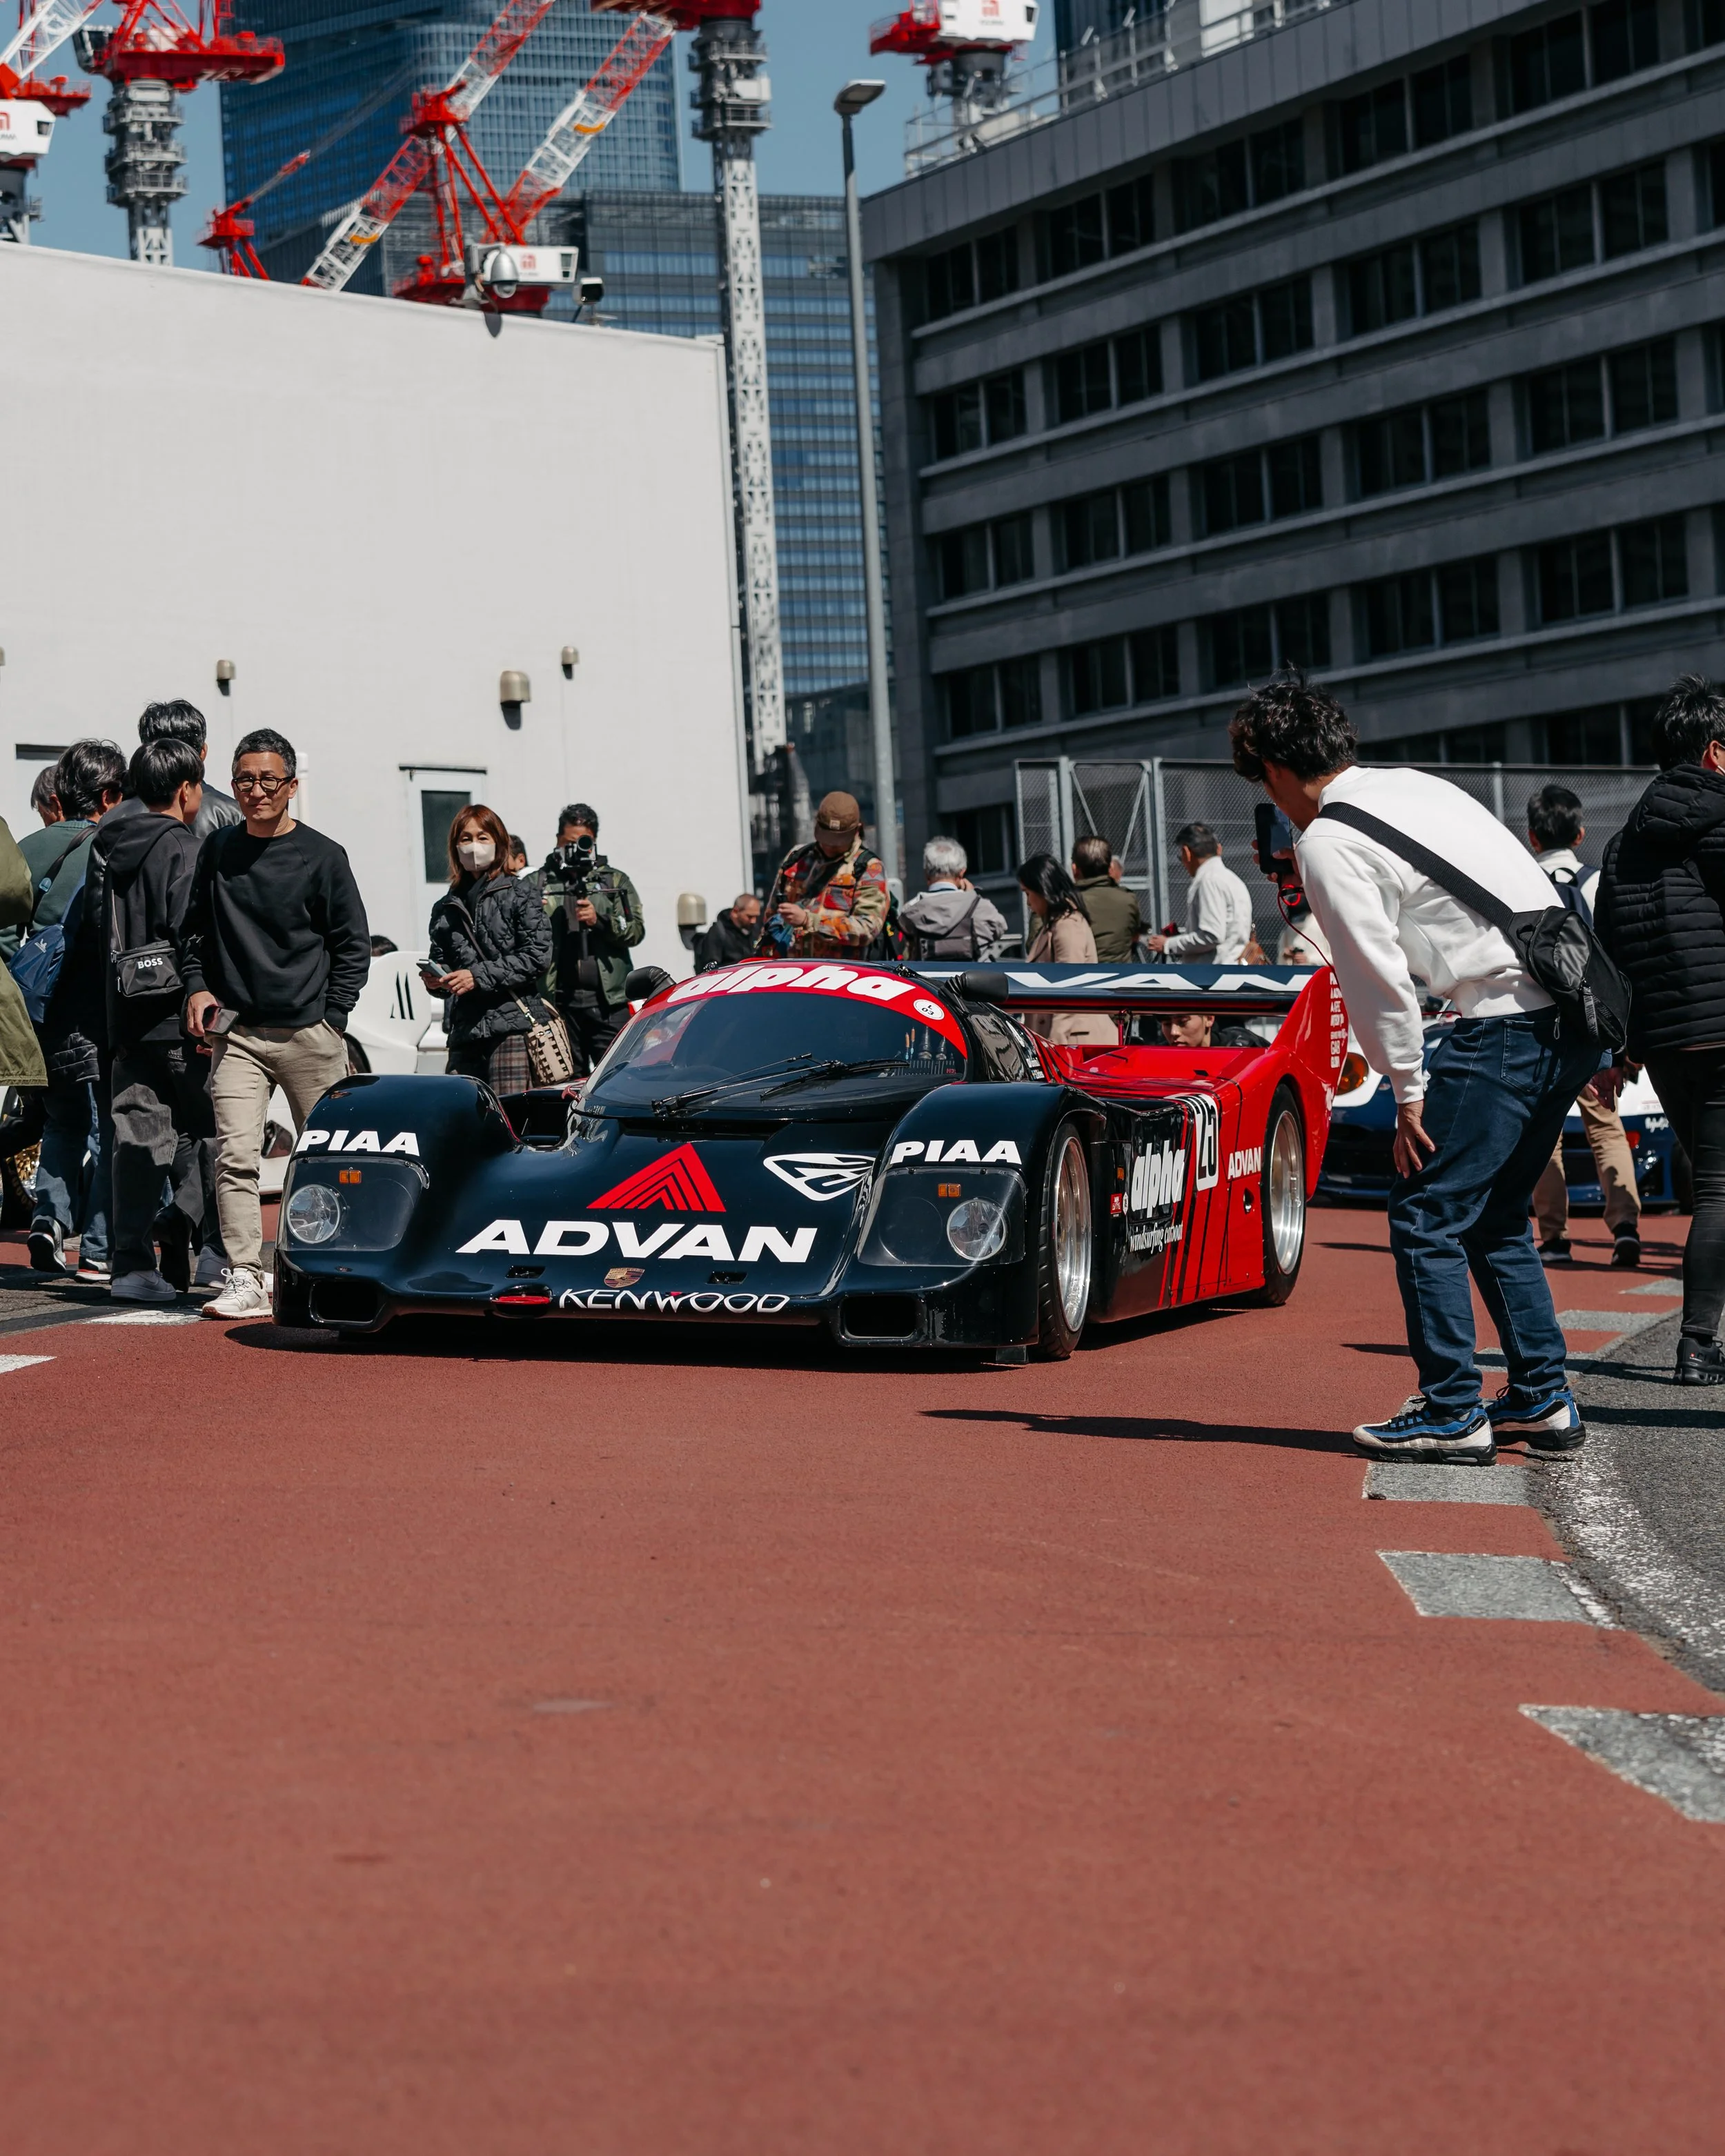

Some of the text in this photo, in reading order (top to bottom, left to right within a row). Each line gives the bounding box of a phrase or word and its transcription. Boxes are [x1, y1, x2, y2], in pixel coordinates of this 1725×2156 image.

[137, 957, 163, 969] BOSS
[667, 965, 916, 1003] alpha
[295, 1130, 420, 1157] PIAA
[890, 1140, 1022, 1165] PIAA
[1131, 1140, 1185, 1218] alpha
[1228, 1147, 1261, 1180] ADVAN
[455, 1219, 818, 1263] ADVAN
[1130, 1222, 1163, 1254] windsurfing
[559, 1288, 791, 1313] KENWOOD
